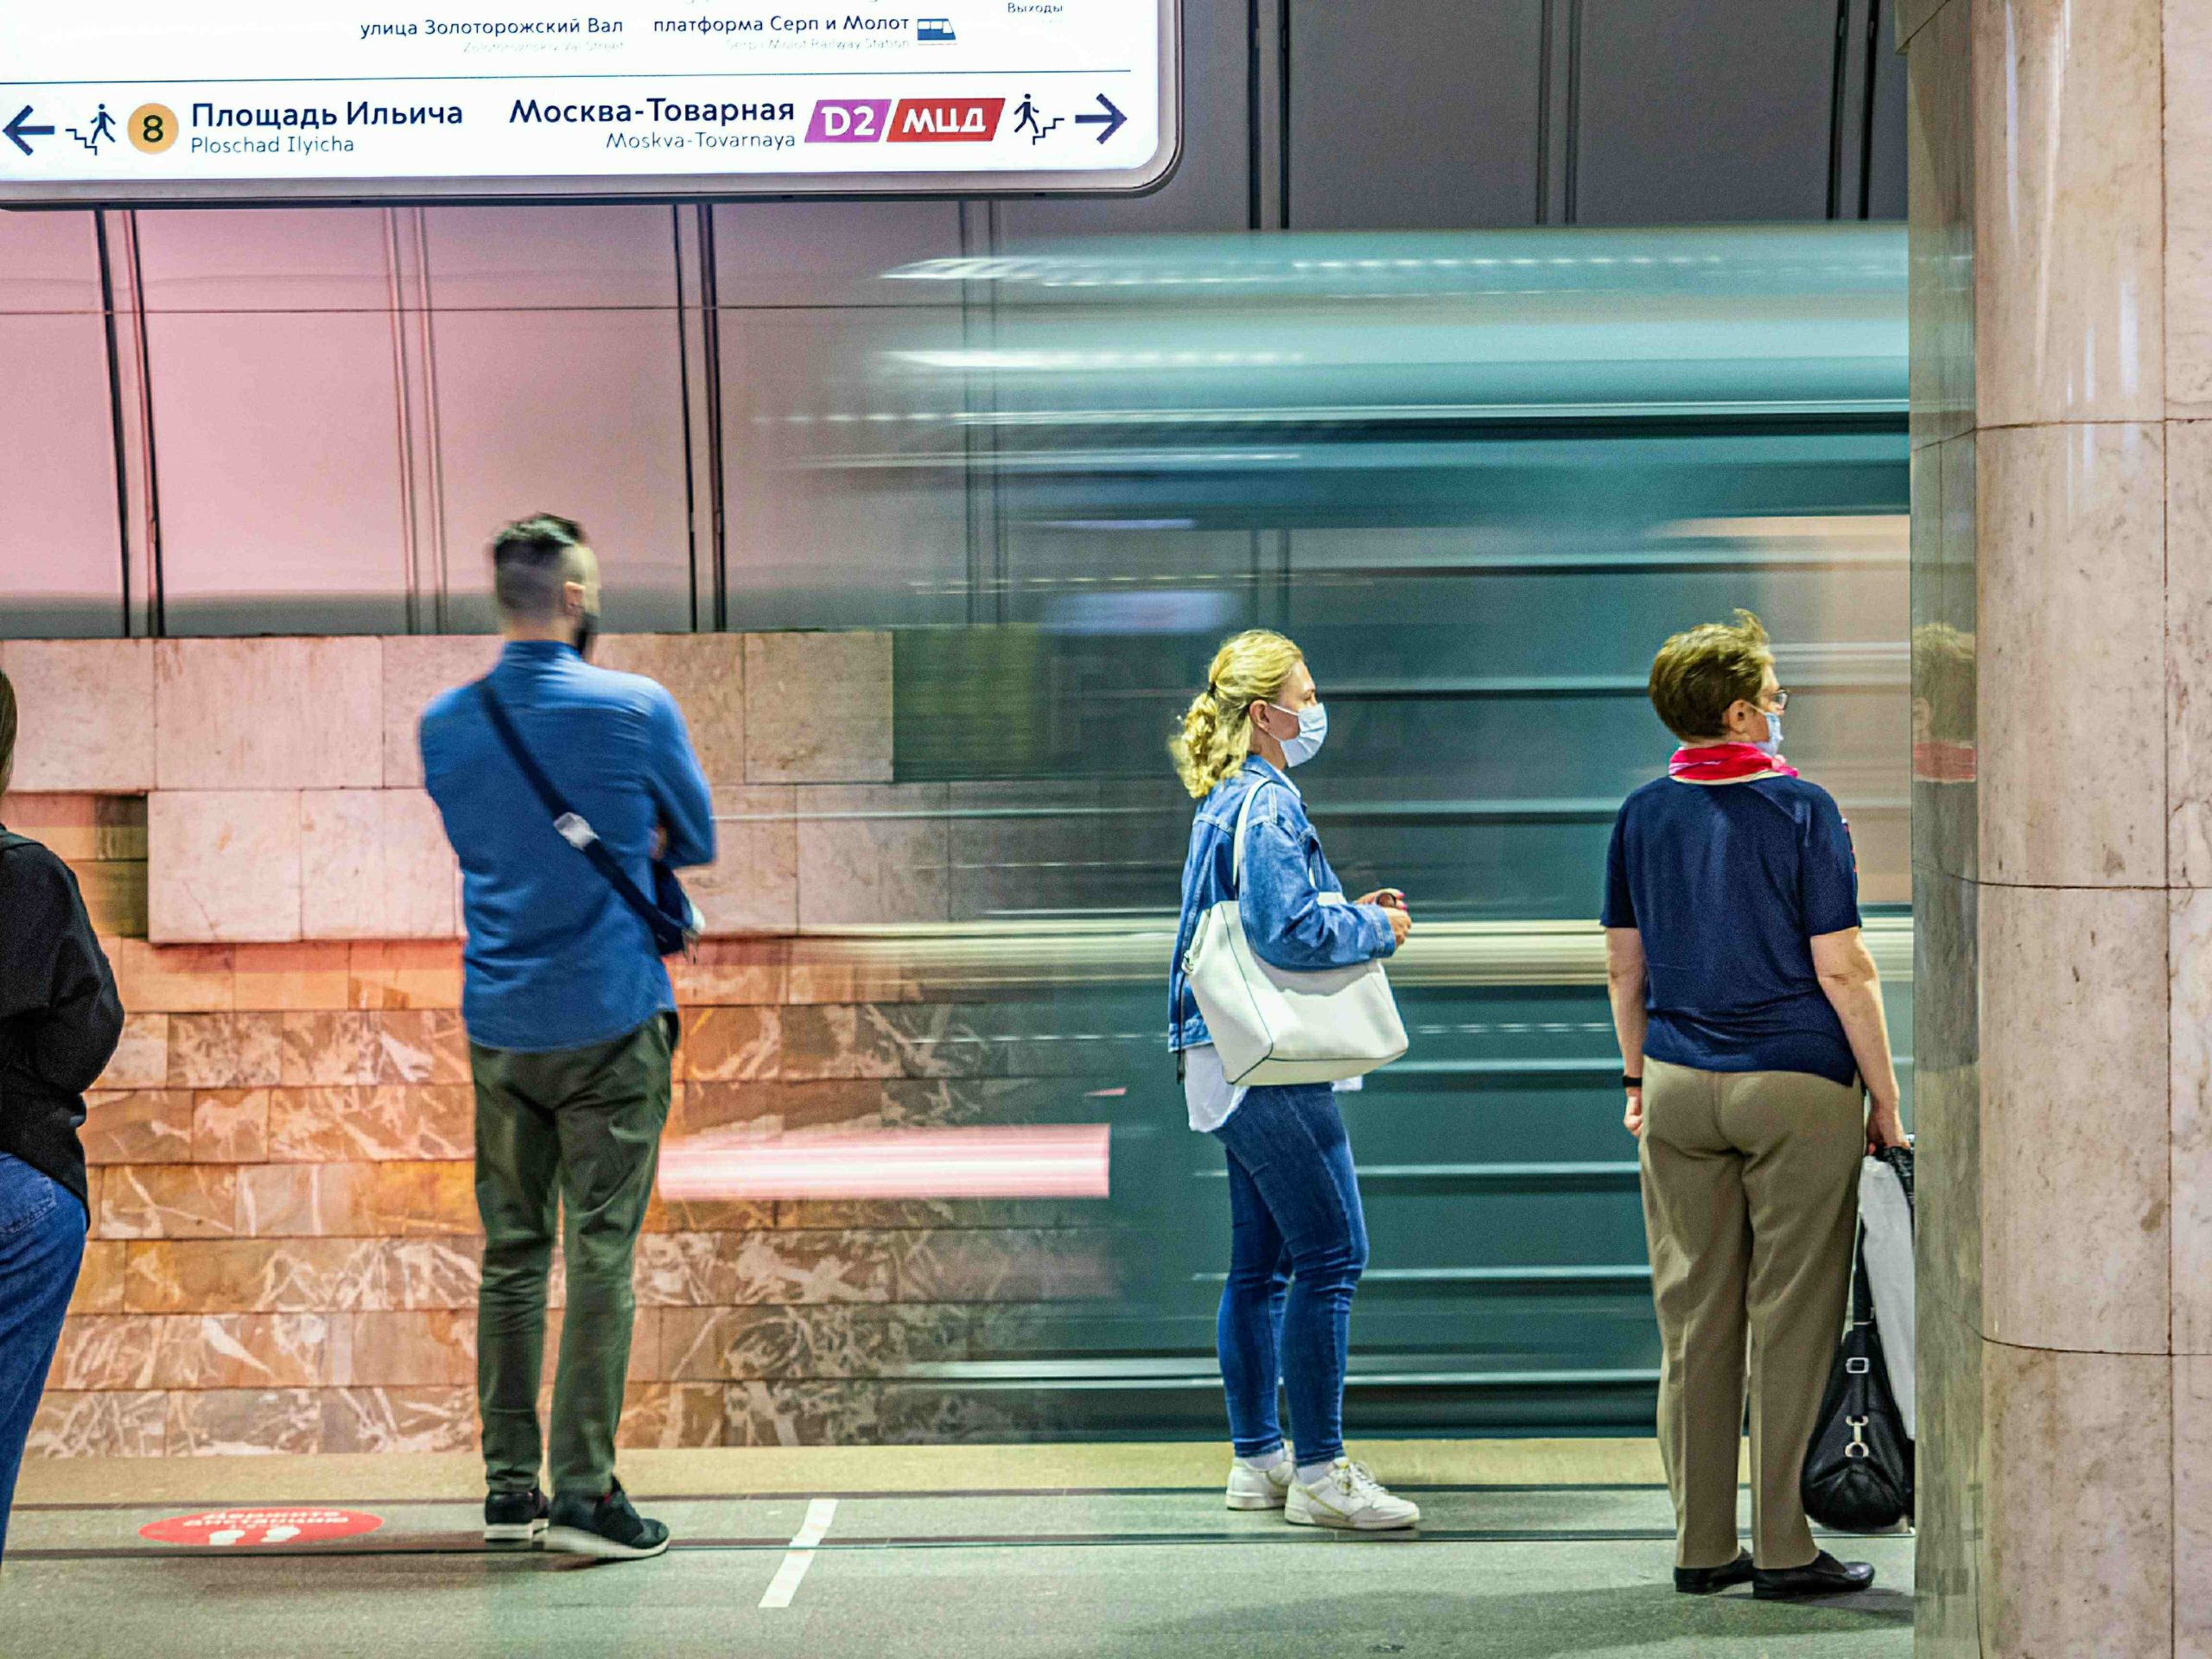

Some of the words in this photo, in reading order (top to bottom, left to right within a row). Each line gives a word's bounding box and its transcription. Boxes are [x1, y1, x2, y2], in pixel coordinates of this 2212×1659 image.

[1007, 2, 1063, 15] Выходы
[360, 23, 417, 40] улица
[424, 18, 580, 38] Золоторожский
[588, 17, 623, 33] Вал
[654, 16, 763, 35] платформа
[770, 15, 818, 35] Серп
[826, 19, 836, 30] и
[842, 15, 910, 30] Молот
[143, 114, 164, 143] 8
[192, 102, 338, 130] Площадь
[346, 100, 462, 125] Ильича
[509, 97, 794, 127] Москва-Товарная
[821, 105, 876, 137] D2
[901, 107, 987, 134] МЦД
[191, 136, 280, 154] Ploschad
[287, 135, 354, 156] Ilyicha
[606, 126, 796, 151] Moskva-Tovarnaya
